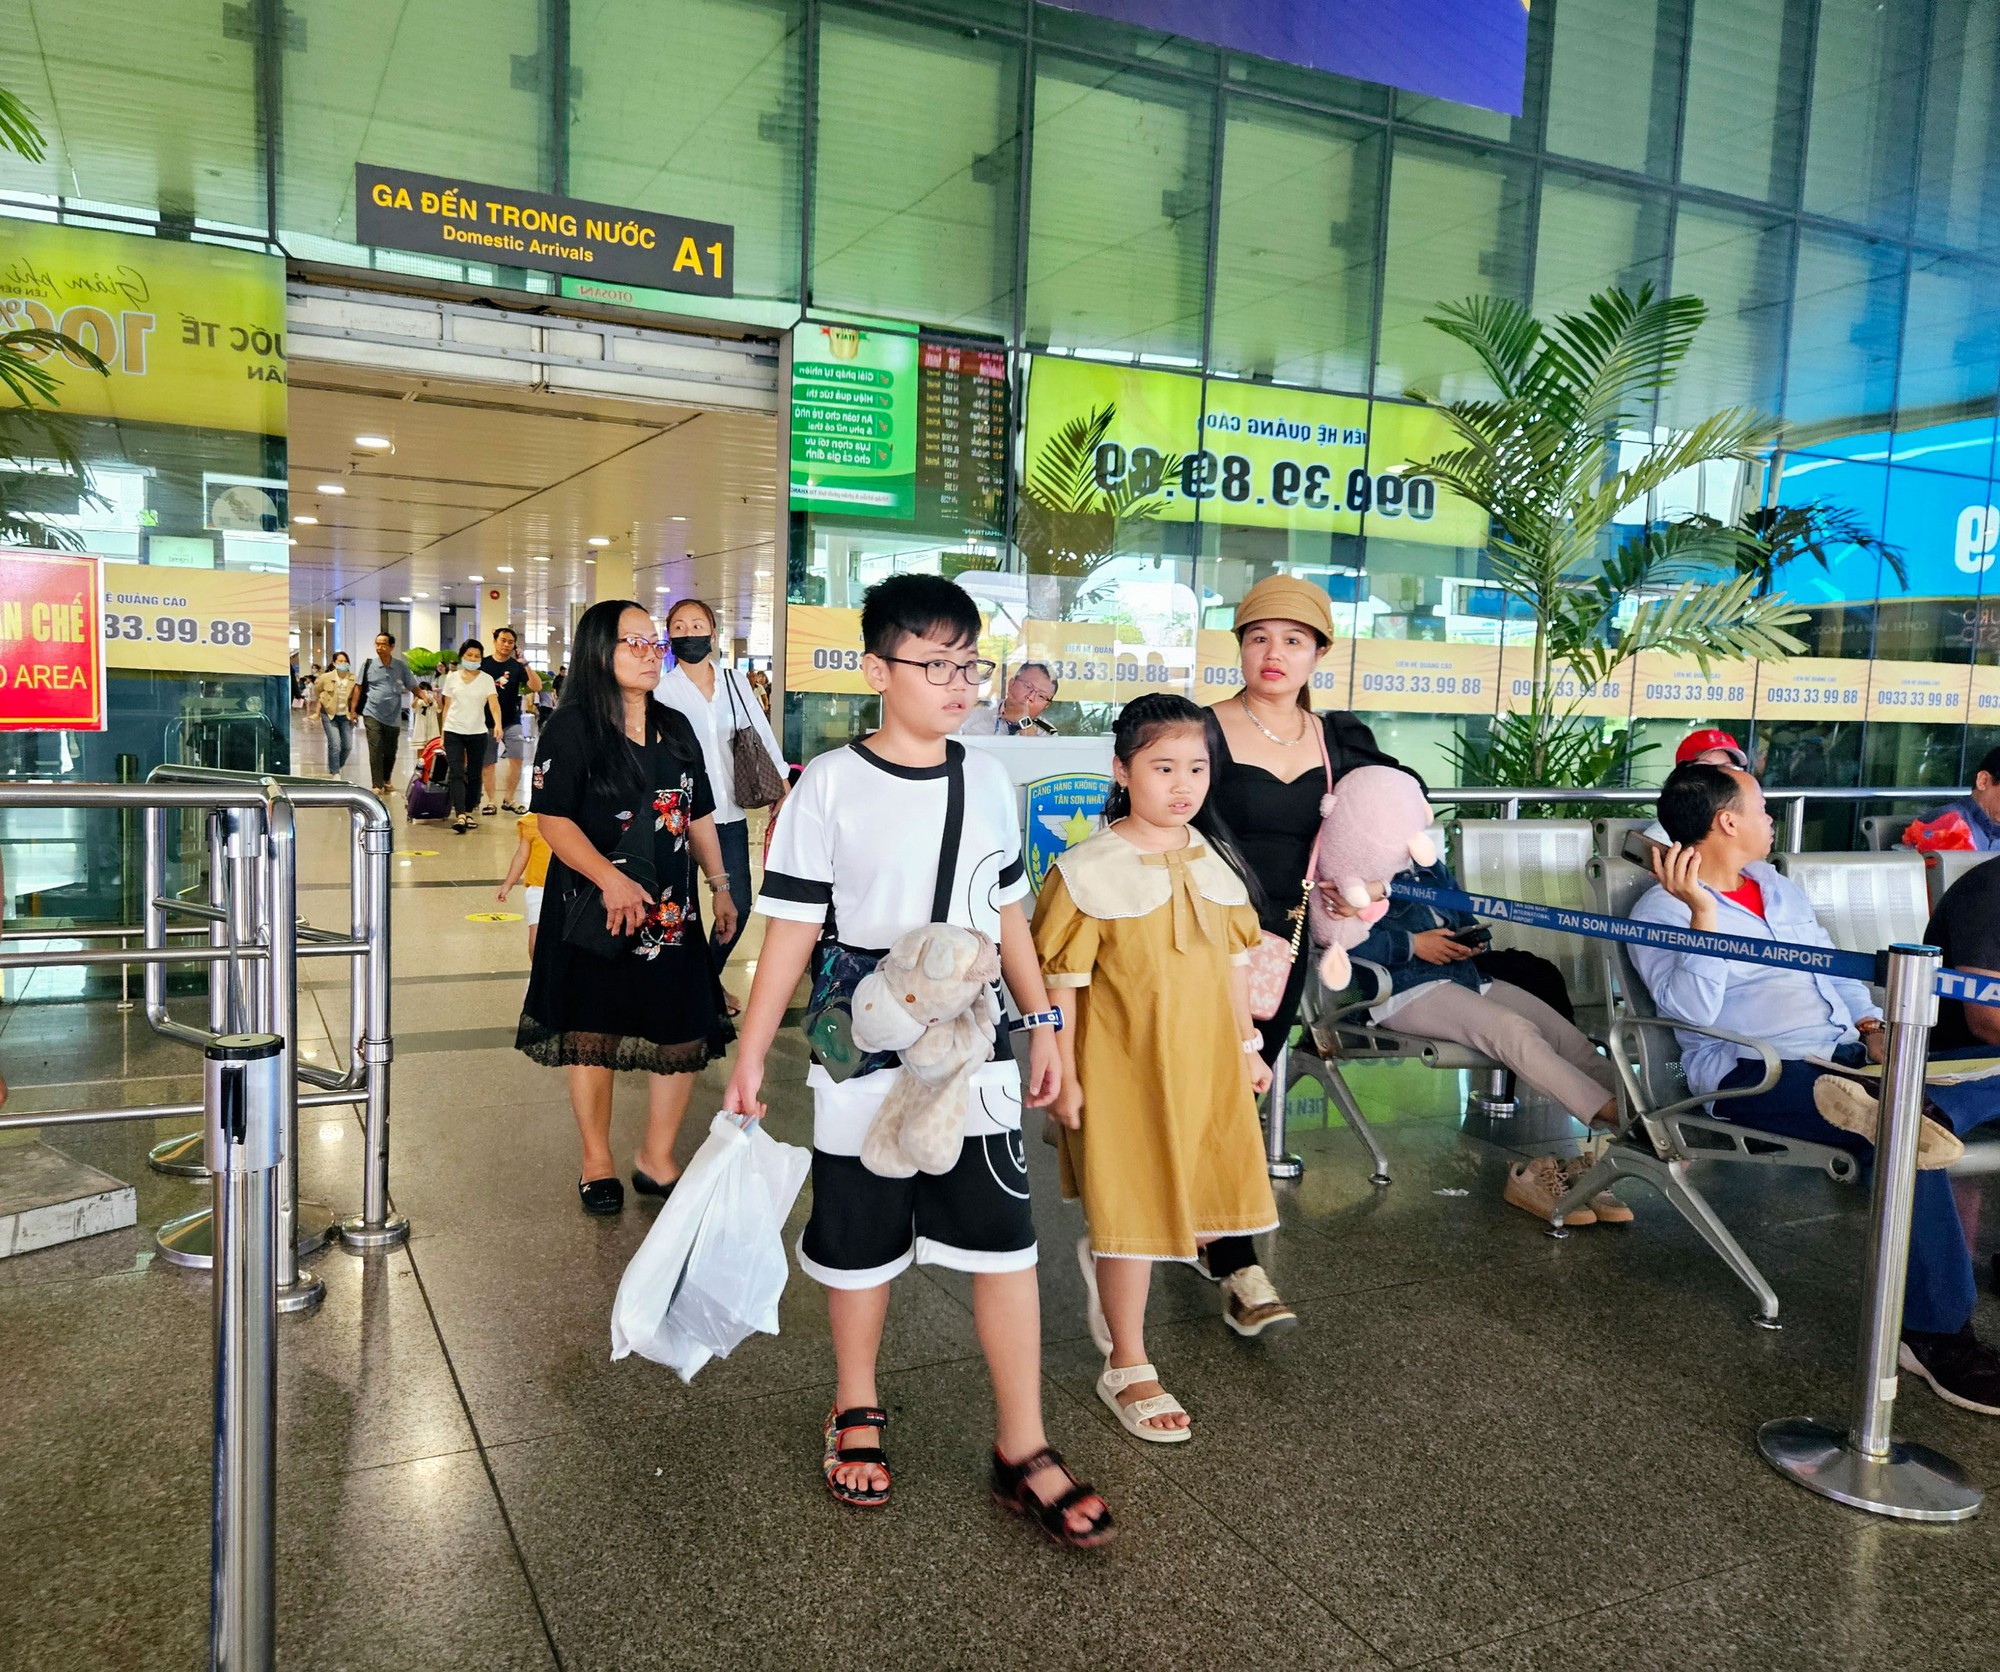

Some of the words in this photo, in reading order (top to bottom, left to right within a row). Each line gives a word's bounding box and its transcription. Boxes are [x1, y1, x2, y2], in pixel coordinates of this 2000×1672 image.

[372, 183, 412, 212] GA
[421, 188, 477, 221] ĐẾN
[485, 202, 577, 238] TRONG
[586, 218, 656, 250] NƯỚC
[443, 224, 525, 253] Domestic
[529, 238, 594, 263] Arrivals
[672, 236, 724, 279] A1
[117, 593, 158, 606] QUẢNG
[163, 594, 187, 607] CÁO
[0, 601, 22, 641] N
[31, 592, 85, 643] CHẾ
[14, 664, 88, 690] AREA
[1054, 660, 1169, 683] 33.33.99.88
[1363, 673, 1481, 695] 0933.33.99.88
[1646, 684, 1745, 702] 0933.33.99.88
[1767, 687, 1858, 704] 0933.33.99.88
[1878, 690, 1960, 707] 0933.33.99.88
[1053, 781, 1073, 793] HÀNG
[1074, 779, 1098, 790] KHÔNG
[1099, 782, 1108, 793] QU
[1054, 793, 1068, 805] TÂN
[1086, 793, 1106, 805] NHẤT
[1412, 886, 1438, 901] NHẤT
[1469, 896, 1508, 918] TIA
[1557, 913, 1579, 928] TAN
[1582, 918, 1608, 933] SON
[1611, 922, 1645, 938] NHAT
[1647, 928, 1759, 958] INTERNATIONAL
[1762, 944, 1834, 969] AIRPORT
